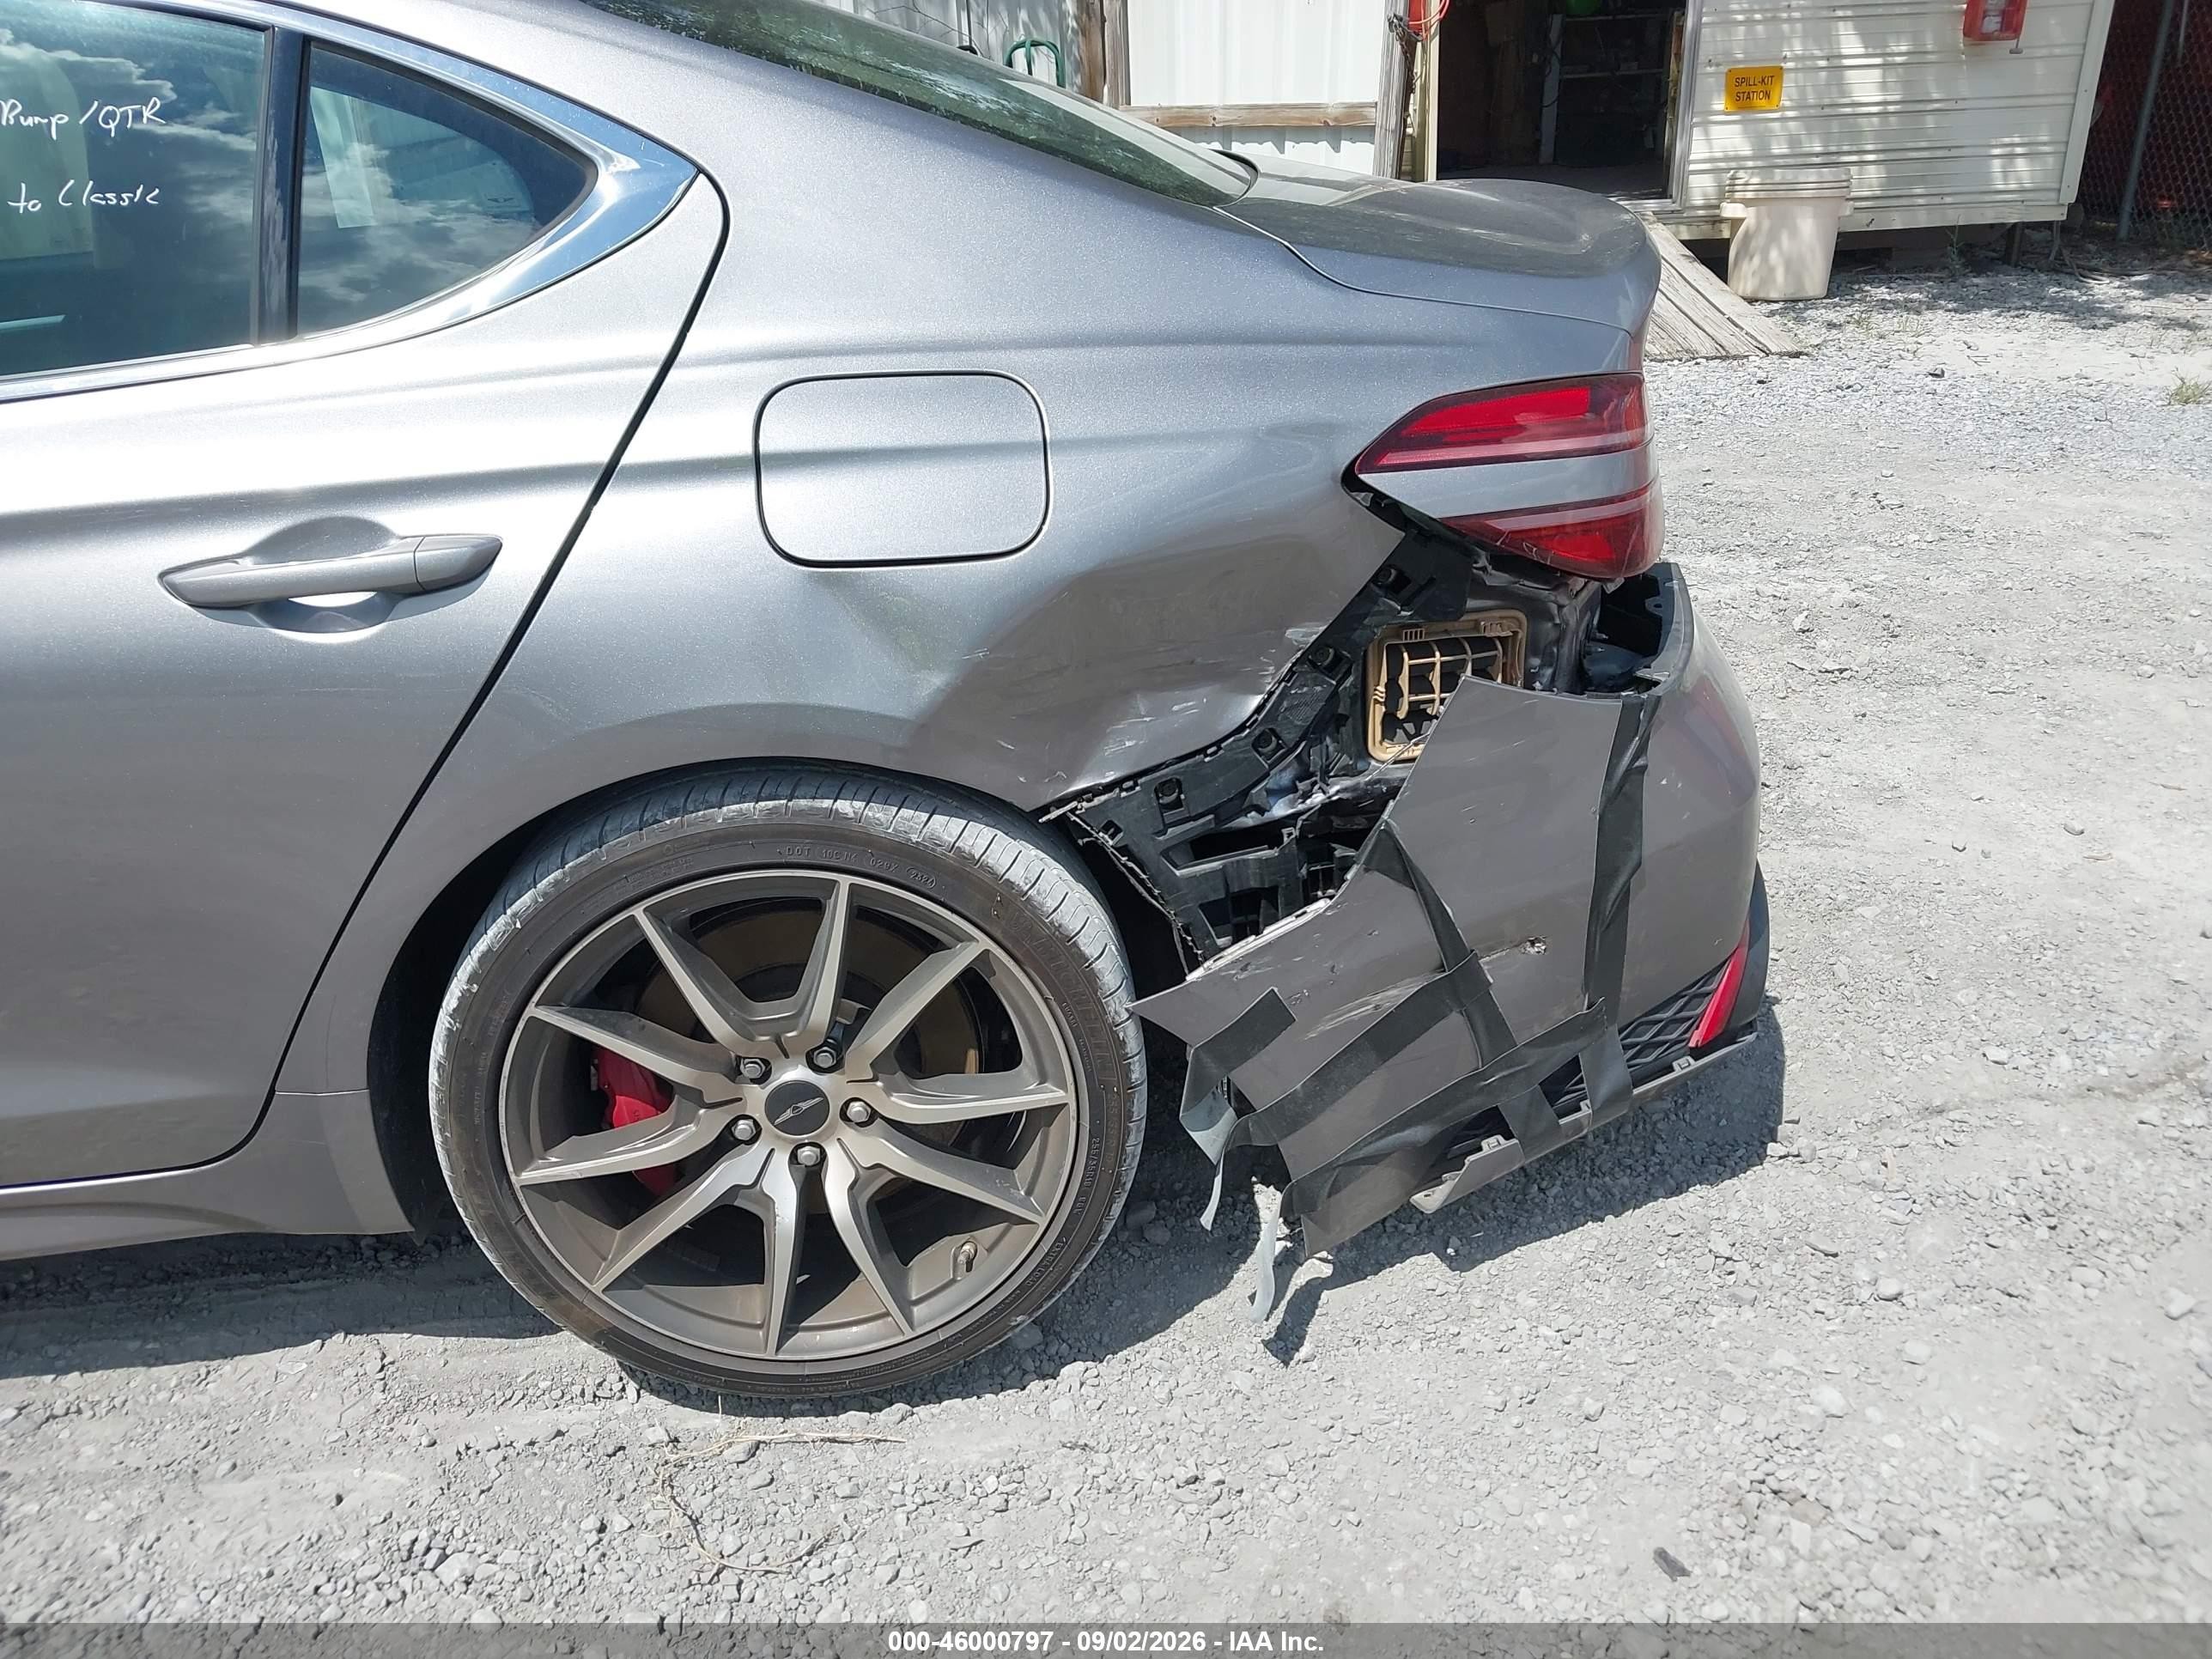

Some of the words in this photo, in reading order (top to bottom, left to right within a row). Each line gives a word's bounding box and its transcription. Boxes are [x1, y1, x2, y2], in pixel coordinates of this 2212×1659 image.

[1735, 75, 1775, 88] SPILL-KIT
[1735, 89, 1771, 101] STATION
[7, 182, 42, 214] to
[785, 846, 811, 857] DOT
